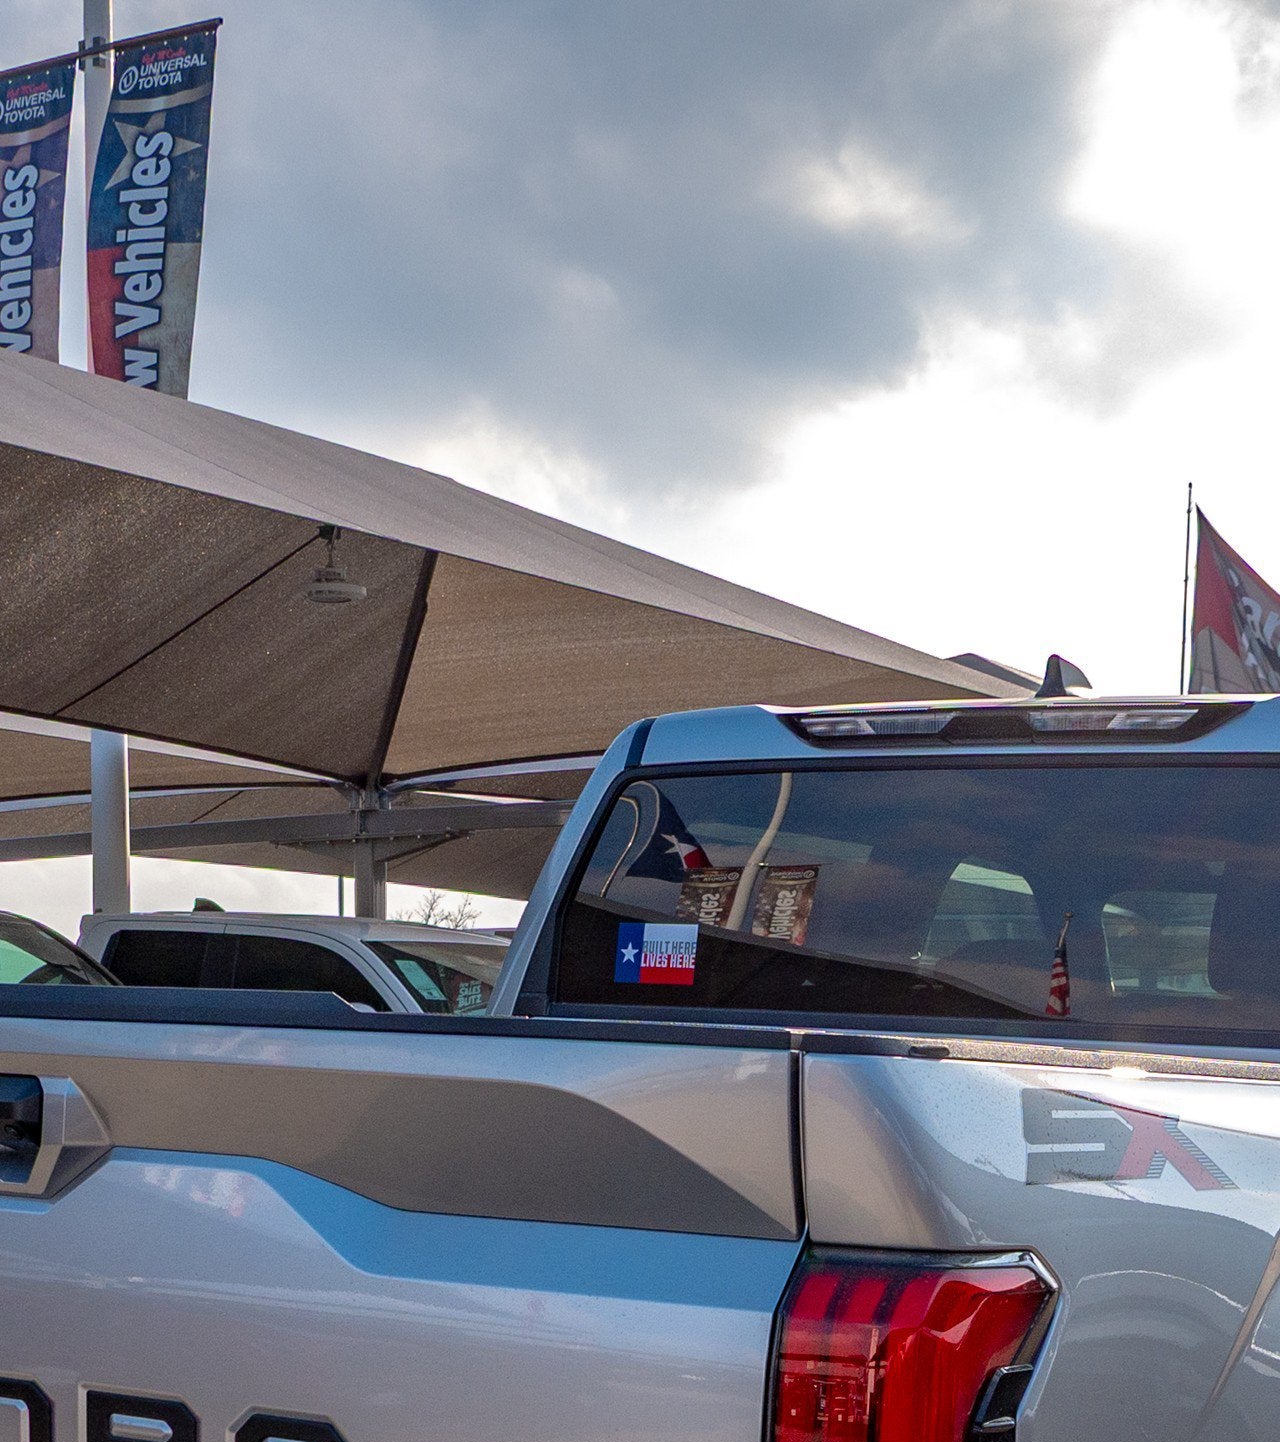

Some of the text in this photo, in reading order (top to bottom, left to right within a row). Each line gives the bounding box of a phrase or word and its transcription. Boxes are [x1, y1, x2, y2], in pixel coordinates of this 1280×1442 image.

[140, 54, 207, 77] UNIVERSAL
[138, 71, 182, 90] TOYOTA
[5, 87, 66, 111] UNIVERSAL
[4, 105, 46, 124] TOYOTA
[114, 130, 175, 339] Vehicles
[643, 940, 697, 954] BUILT HERE
[641, 953, 696, 969] LIVES HERE
